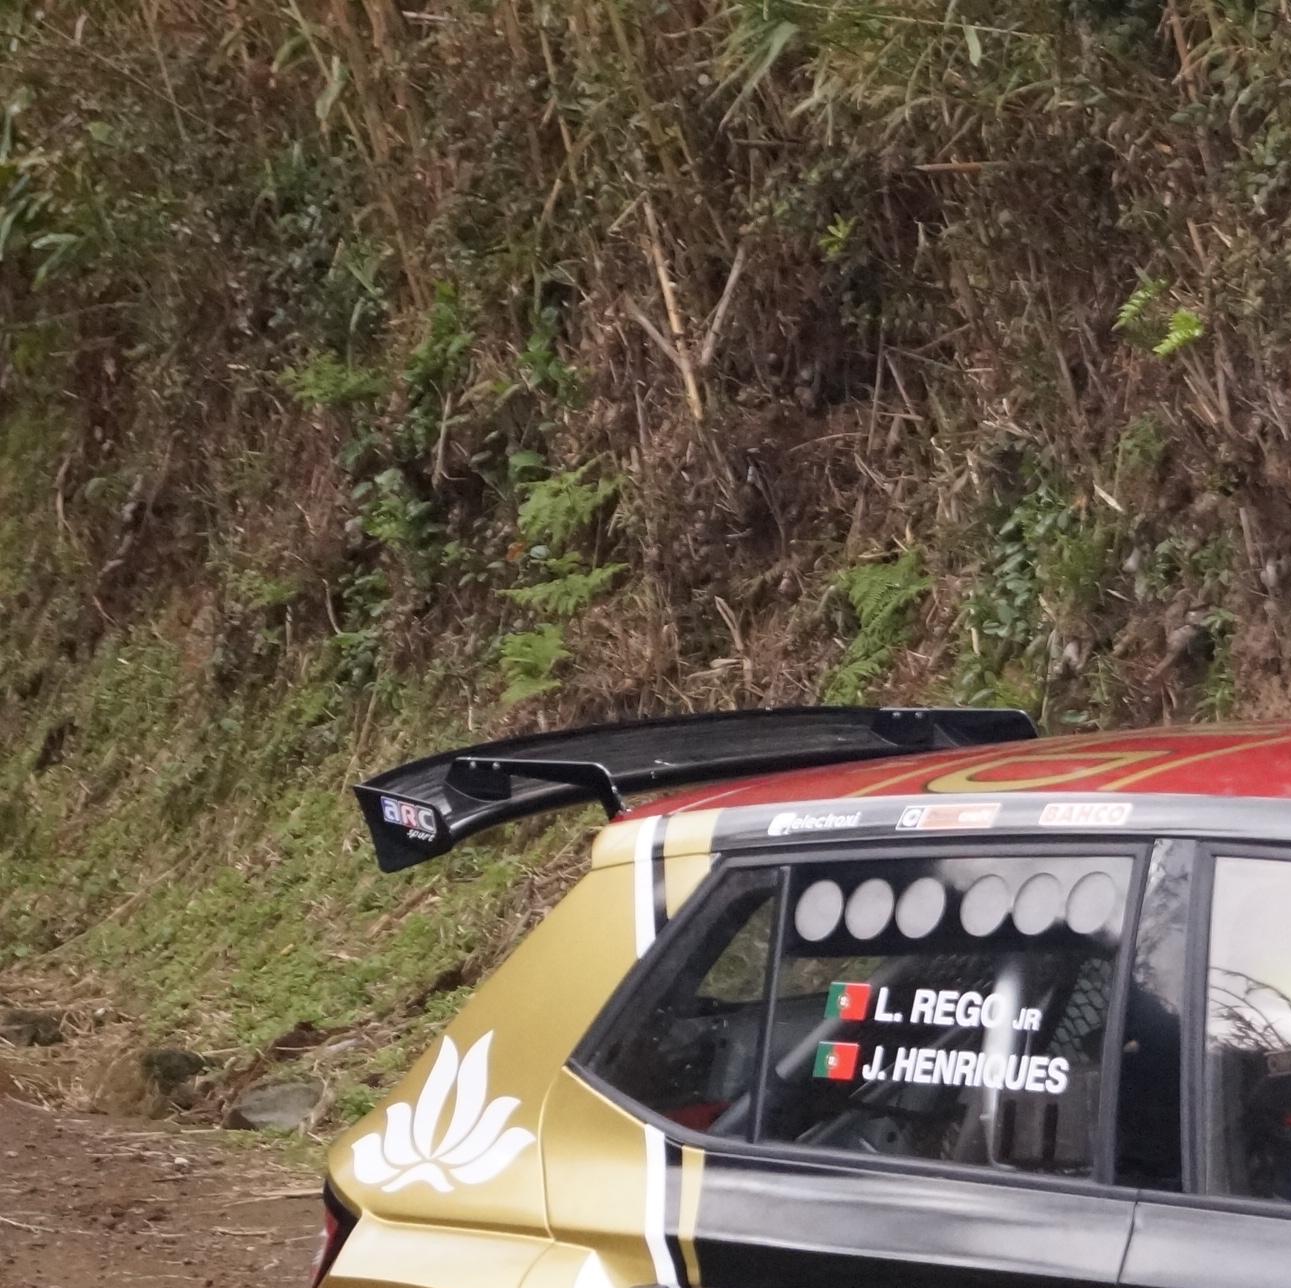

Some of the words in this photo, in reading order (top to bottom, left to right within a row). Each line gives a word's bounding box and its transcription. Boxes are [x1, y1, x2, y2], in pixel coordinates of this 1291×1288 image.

[1047, 805, 1128, 825] BAHCO
[874, 986, 904, 1022] L.
[910, 989, 1011, 1028] REGO
[1012, 1007, 1042, 1031] JR
[862, 1045, 887, 1081] J.
[892, 1047, 1070, 1094] HENRIQUES
